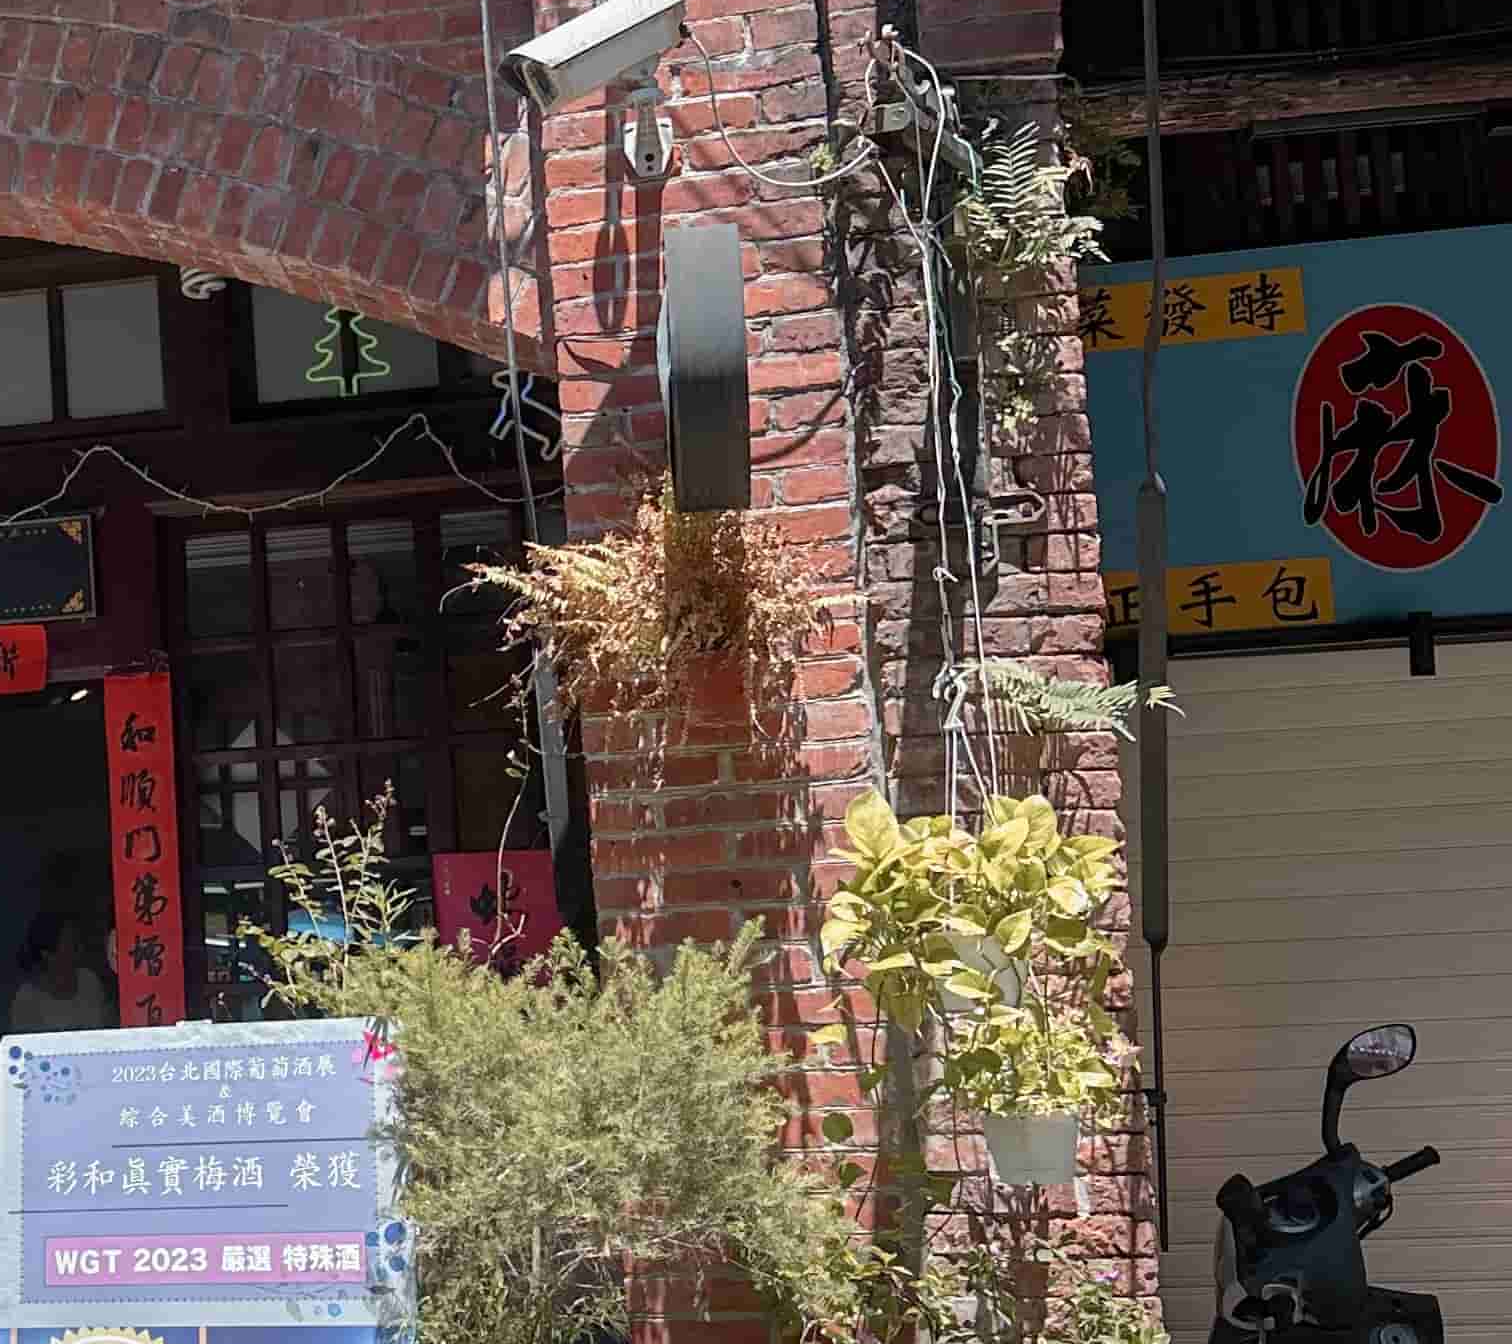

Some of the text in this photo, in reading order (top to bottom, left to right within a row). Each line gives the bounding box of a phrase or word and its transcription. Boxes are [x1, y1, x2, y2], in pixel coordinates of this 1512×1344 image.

[111, 1055, 337, 1083] 2023台北國際葡萄酒展
[218, 1084, 232, 1098] &
[119, 1099, 317, 1128] 綜合美酒博覽會
[289, 1151, 362, 1191] 榮獲
[54, 1243, 362, 1275] WGT 2023 嚴選 特殊酒
